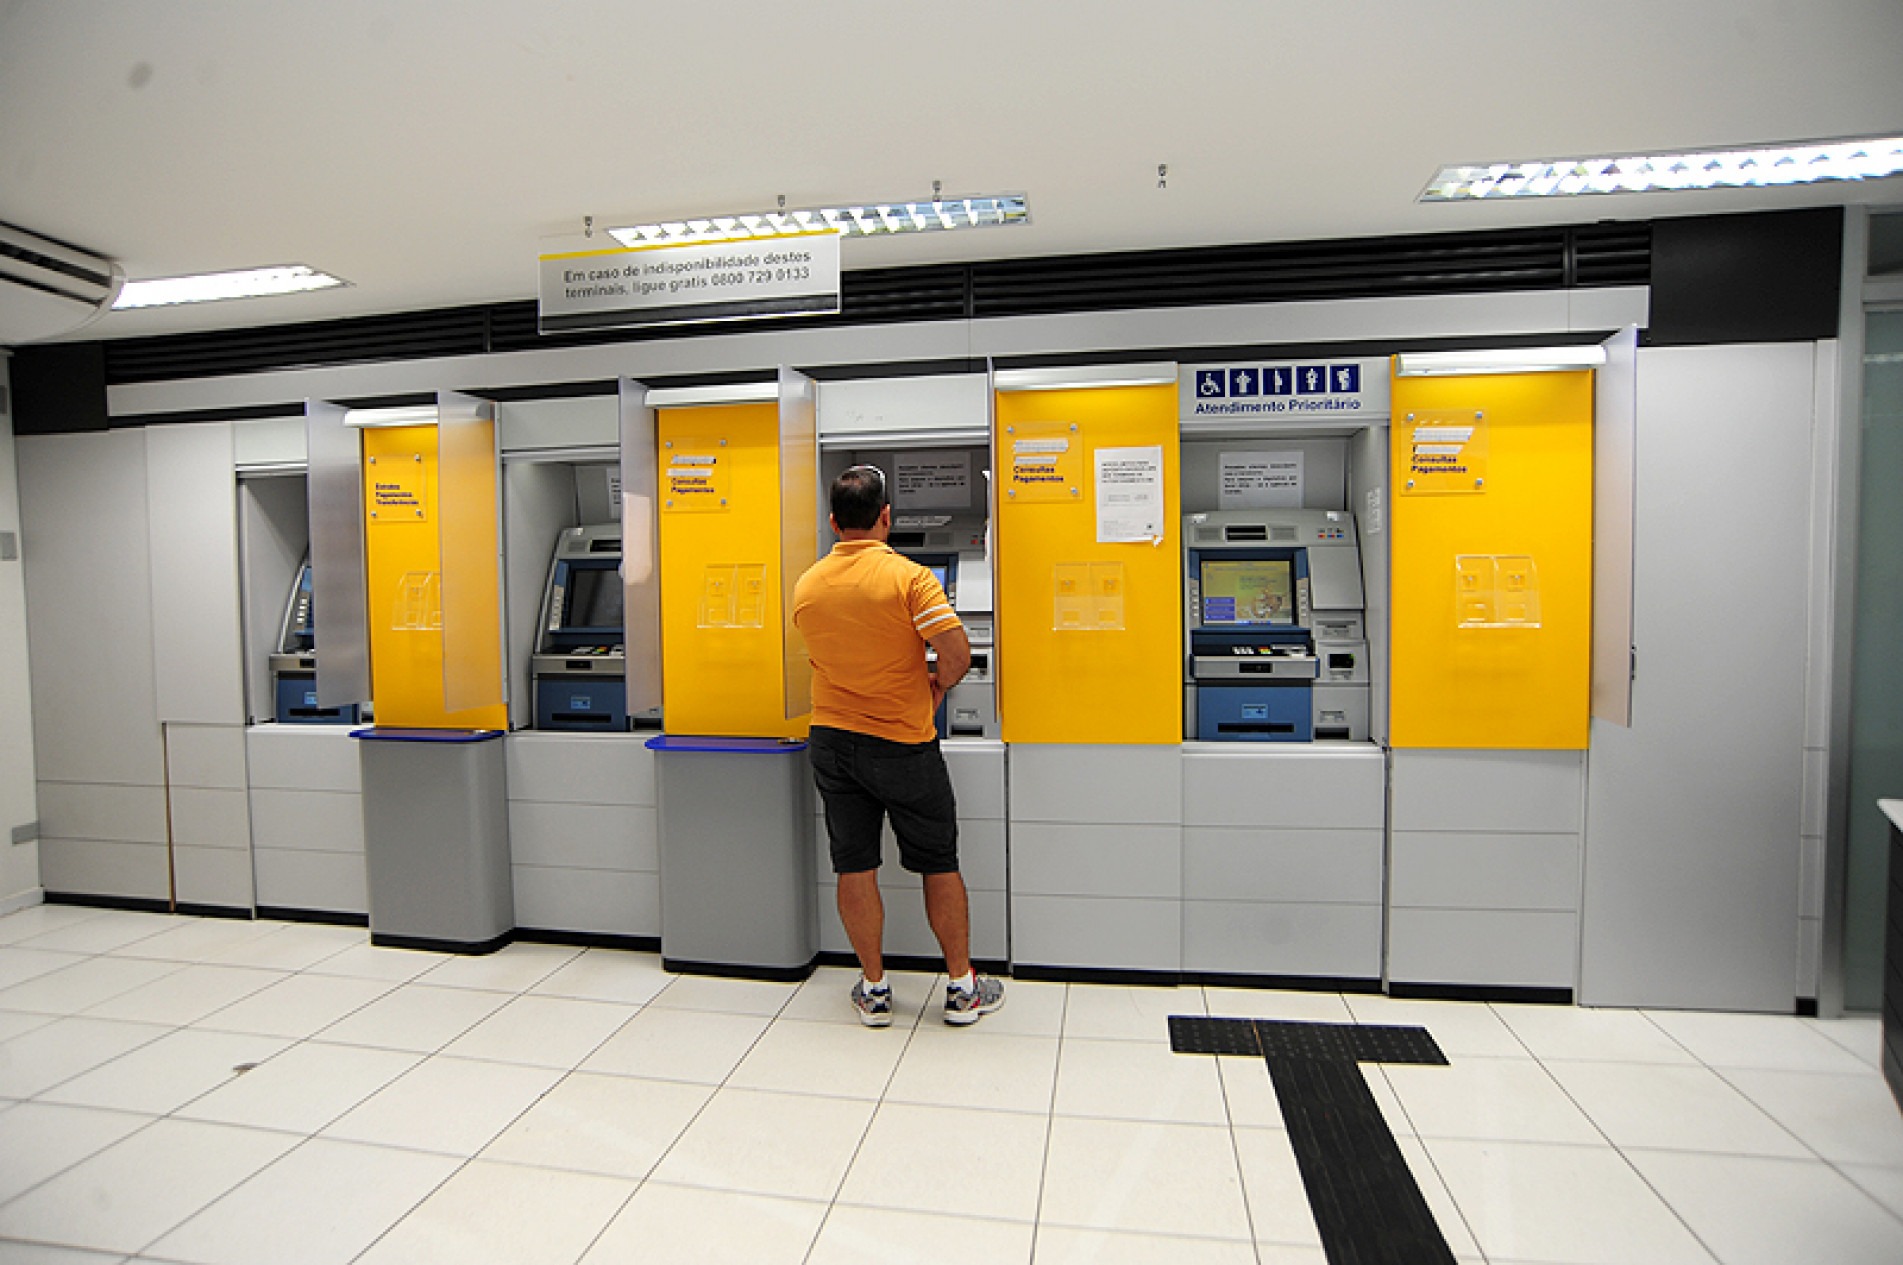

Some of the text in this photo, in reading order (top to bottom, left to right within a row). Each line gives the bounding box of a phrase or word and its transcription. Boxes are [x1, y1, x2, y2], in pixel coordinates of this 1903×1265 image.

[564, 251, 812, 283] Em caso de indisponibilidade destes
[565, 282, 628, 298] terminais,
[632, 280, 667, 295] ligue
[710, 272, 745, 286] 0800
[748, 269, 773, 284] 729
[775, 265, 810, 282] 0133
[1194, 400, 1285, 415] Atendimento
[1411, 453, 1457, 463] Consultas
[1013, 465, 1055, 474] Consultas
[1411, 465, 1467, 475] Pagamentos
[1013, 474, 1064, 484] Pagamentos
[670, 486, 715, 495] Pagamentos
